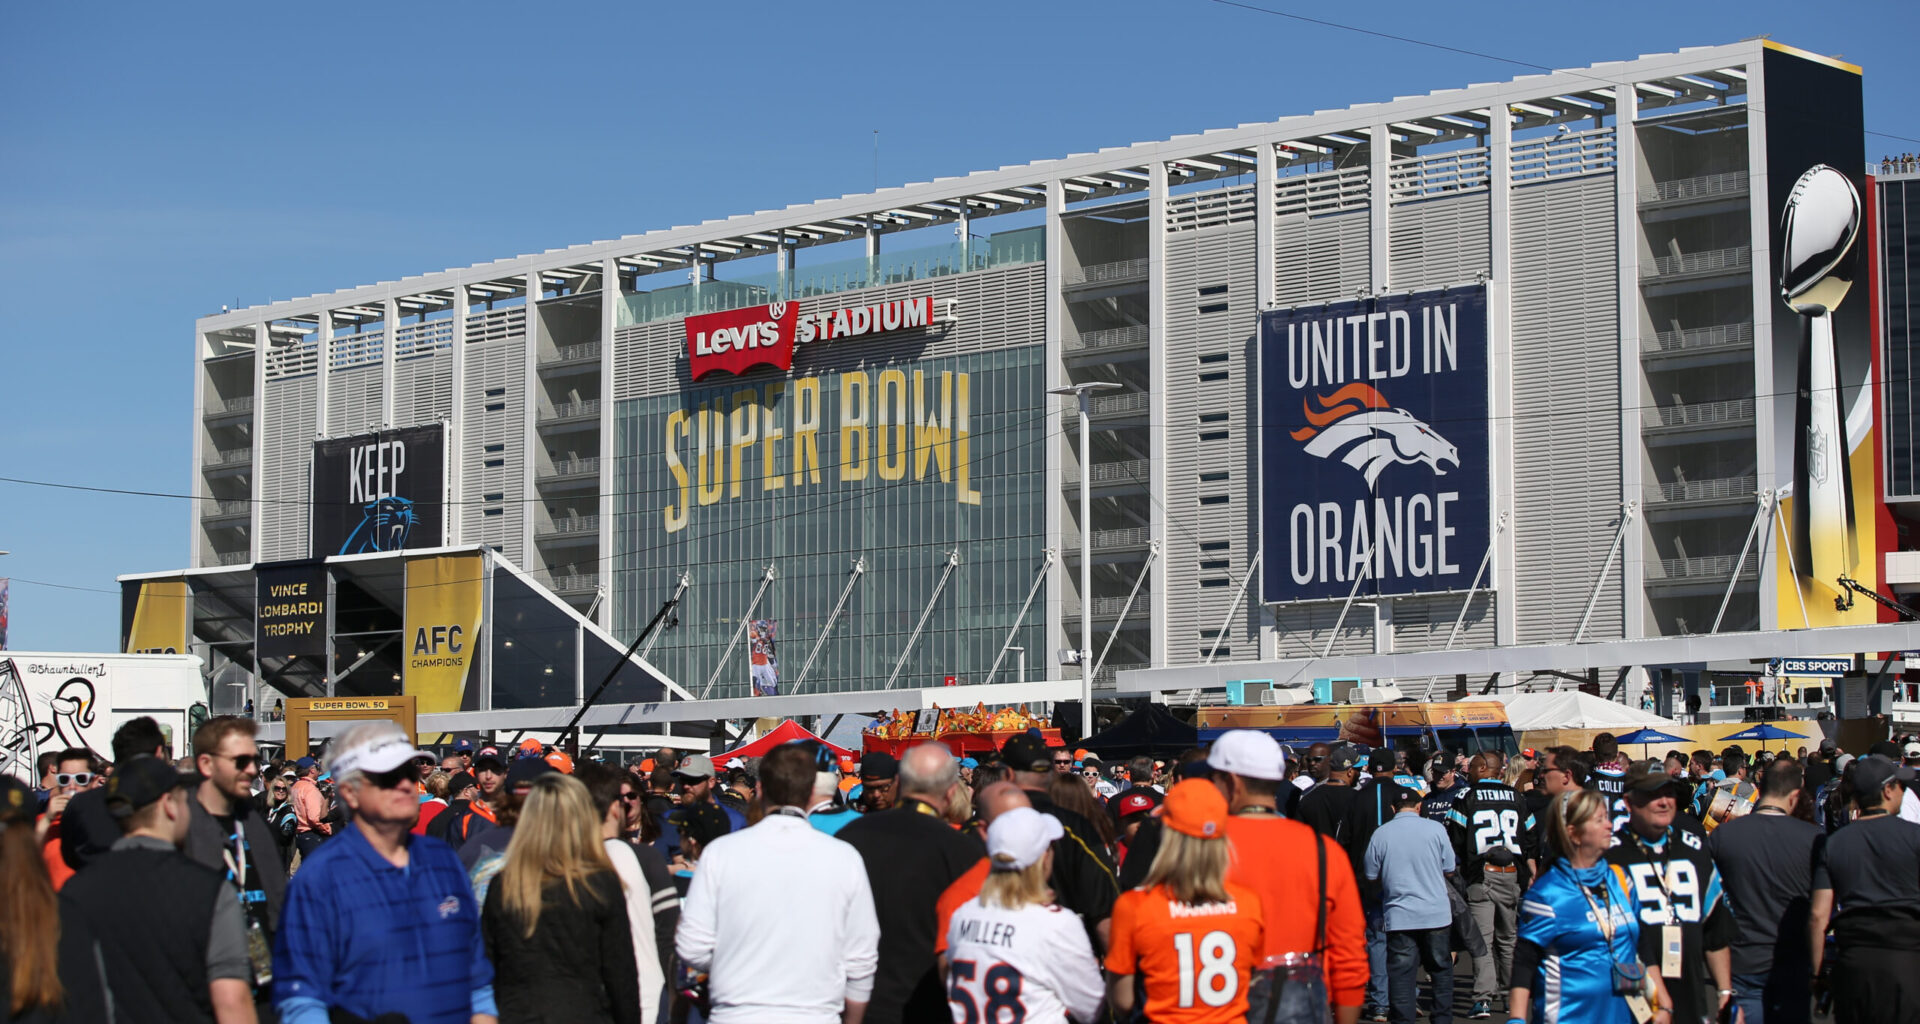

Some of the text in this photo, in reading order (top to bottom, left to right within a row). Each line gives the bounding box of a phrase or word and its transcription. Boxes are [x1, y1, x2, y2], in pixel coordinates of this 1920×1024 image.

[800, 297, 929, 343] STADIUM
[1288, 303, 1458, 390] UNITED IN
[663, 369, 981, 534] SUPER BOWL
[349, 440, 406, 505] KEEP
[1290, 491, 1460, 586] ORANGE
[259, 601, 323, 619] LOMBARDI
[270, 583, 308, 598] VINCE
[264, 621, 315, 637] TROPHY
[412, 624, 463, 656] AFC
[411, 656, 463, 669] CHAMPIONS
[1785, 661, 1849, 672] CBS SPORTS
[313, 701, 385, 710] SUPER BOWL 50
[1476, 788, 1515, 801] STEWART
[1473, 809, 1522, 855] 28
[1628, 859, 1701, 925] 59
[960, 919, 1016, 948] MILLER
[1174, 930, 1239, 1008] 18
[950, 959, 1028, 1024] 58
